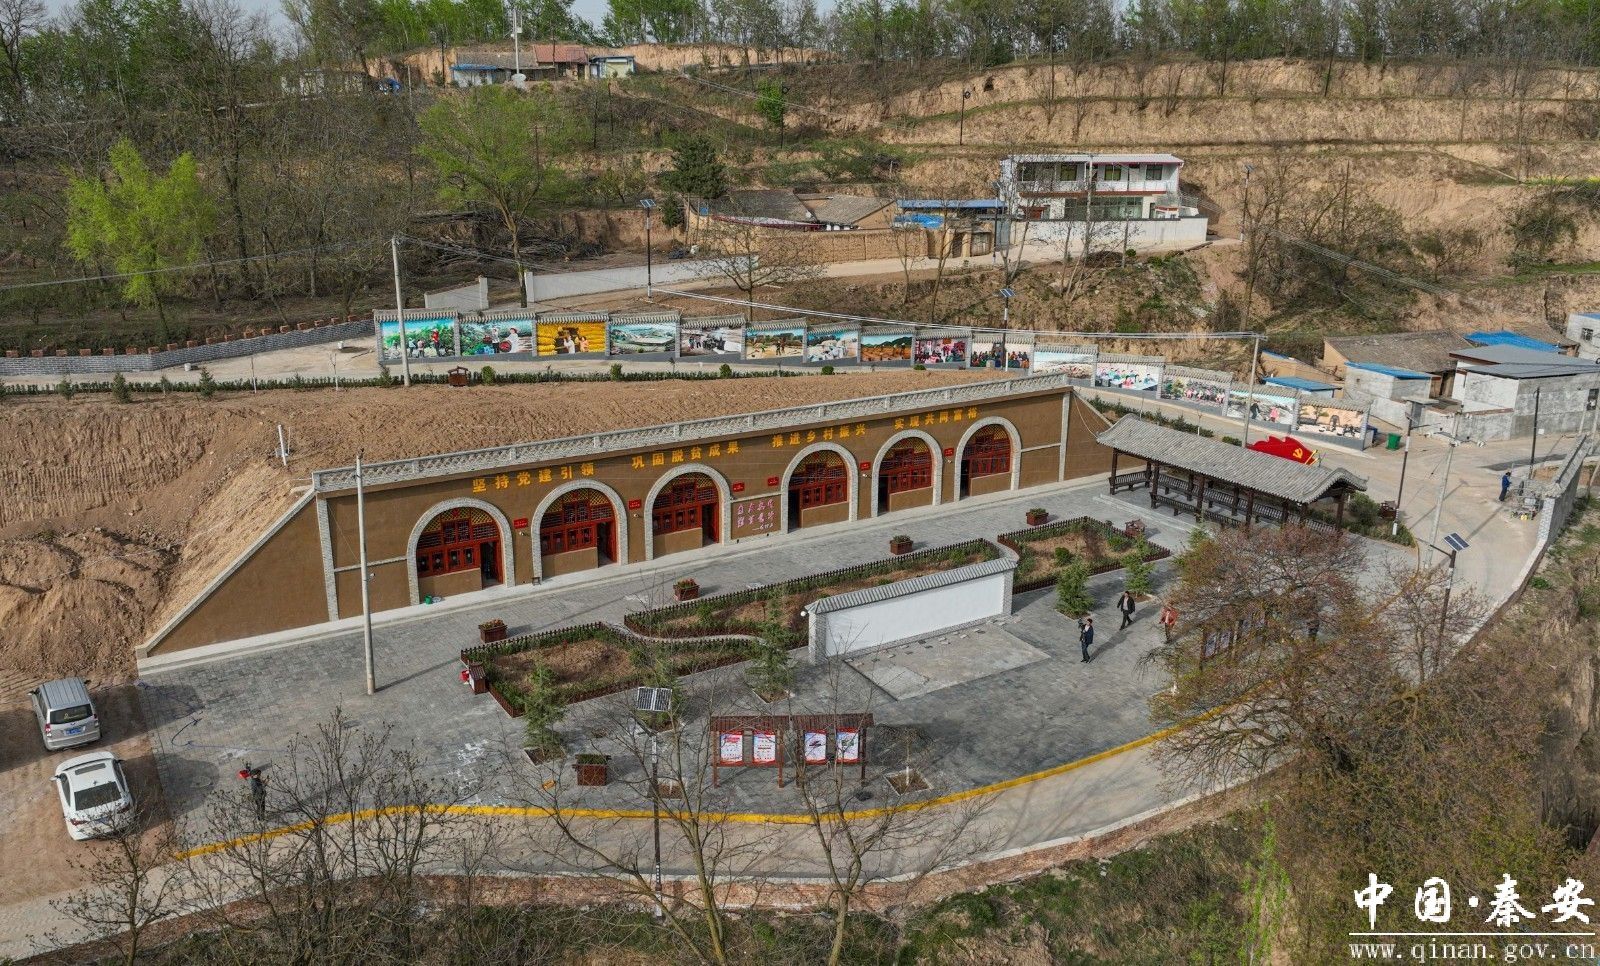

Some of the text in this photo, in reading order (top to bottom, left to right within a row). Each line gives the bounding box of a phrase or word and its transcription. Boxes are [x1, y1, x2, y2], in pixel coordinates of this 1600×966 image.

[472, 407, 979, 493] 坚持党建引领 巩固脱贫成果 推进乡村振兴 实现共同富裕
